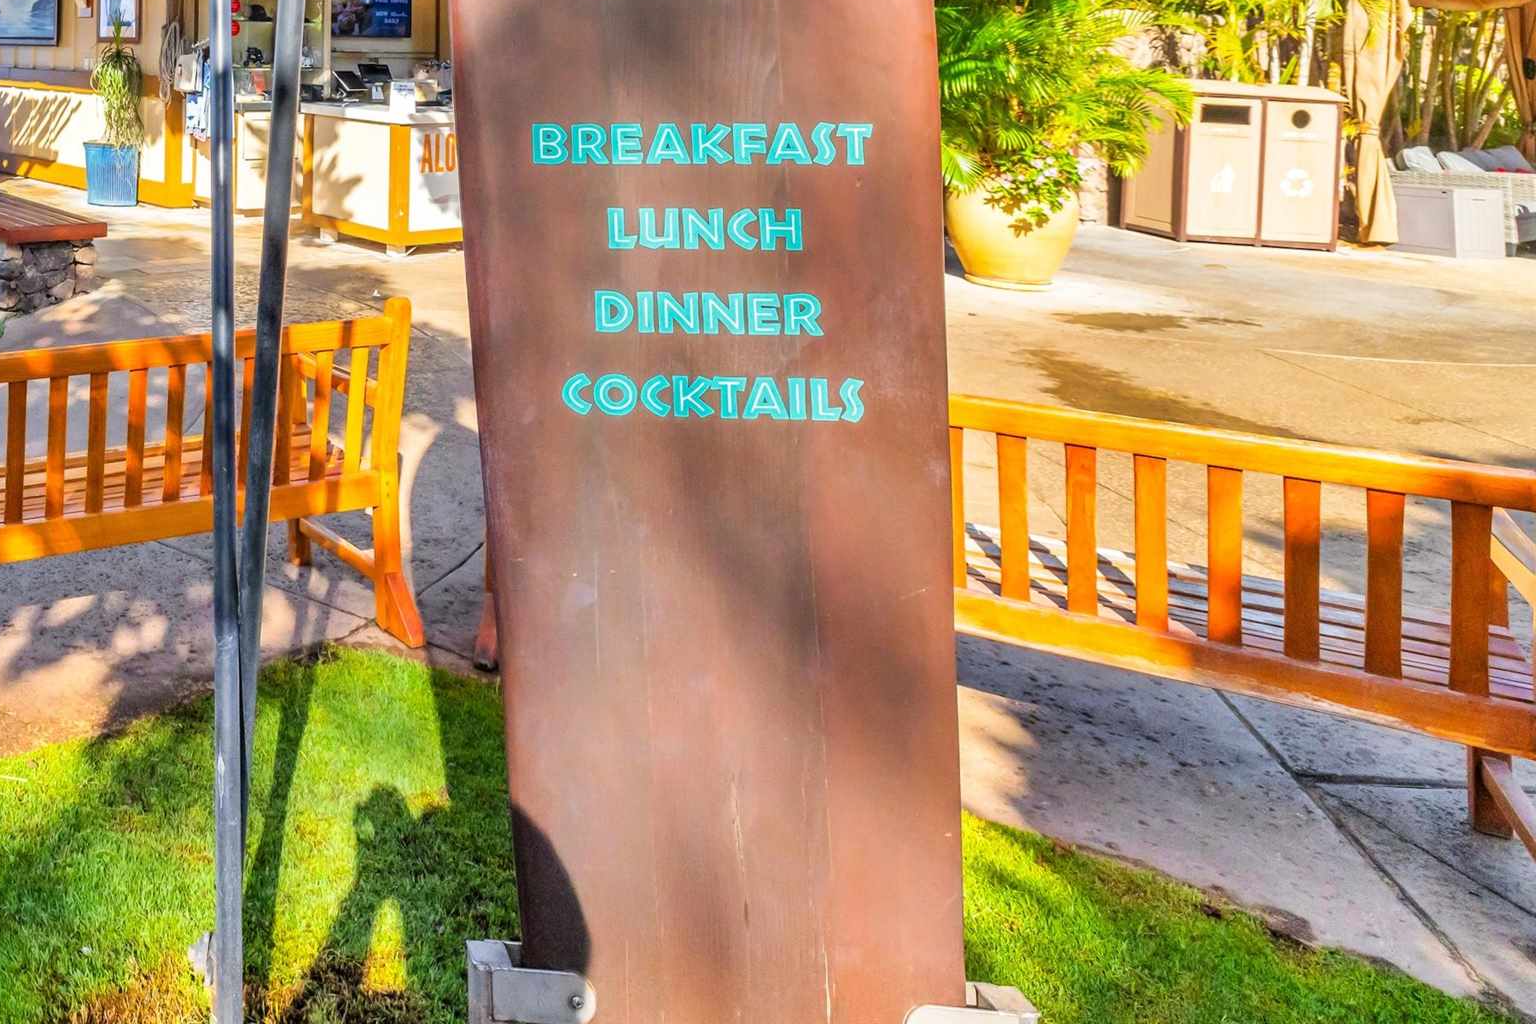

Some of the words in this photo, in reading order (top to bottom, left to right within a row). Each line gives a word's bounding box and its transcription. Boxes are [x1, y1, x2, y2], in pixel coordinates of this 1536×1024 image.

[531, 122, 874, 166] BREAKFAST
[606, 207, 804, 252] LUNCH
[593, 290, 825, 337] DINNER
[561, 372, 866, 423] COCKTAILS
